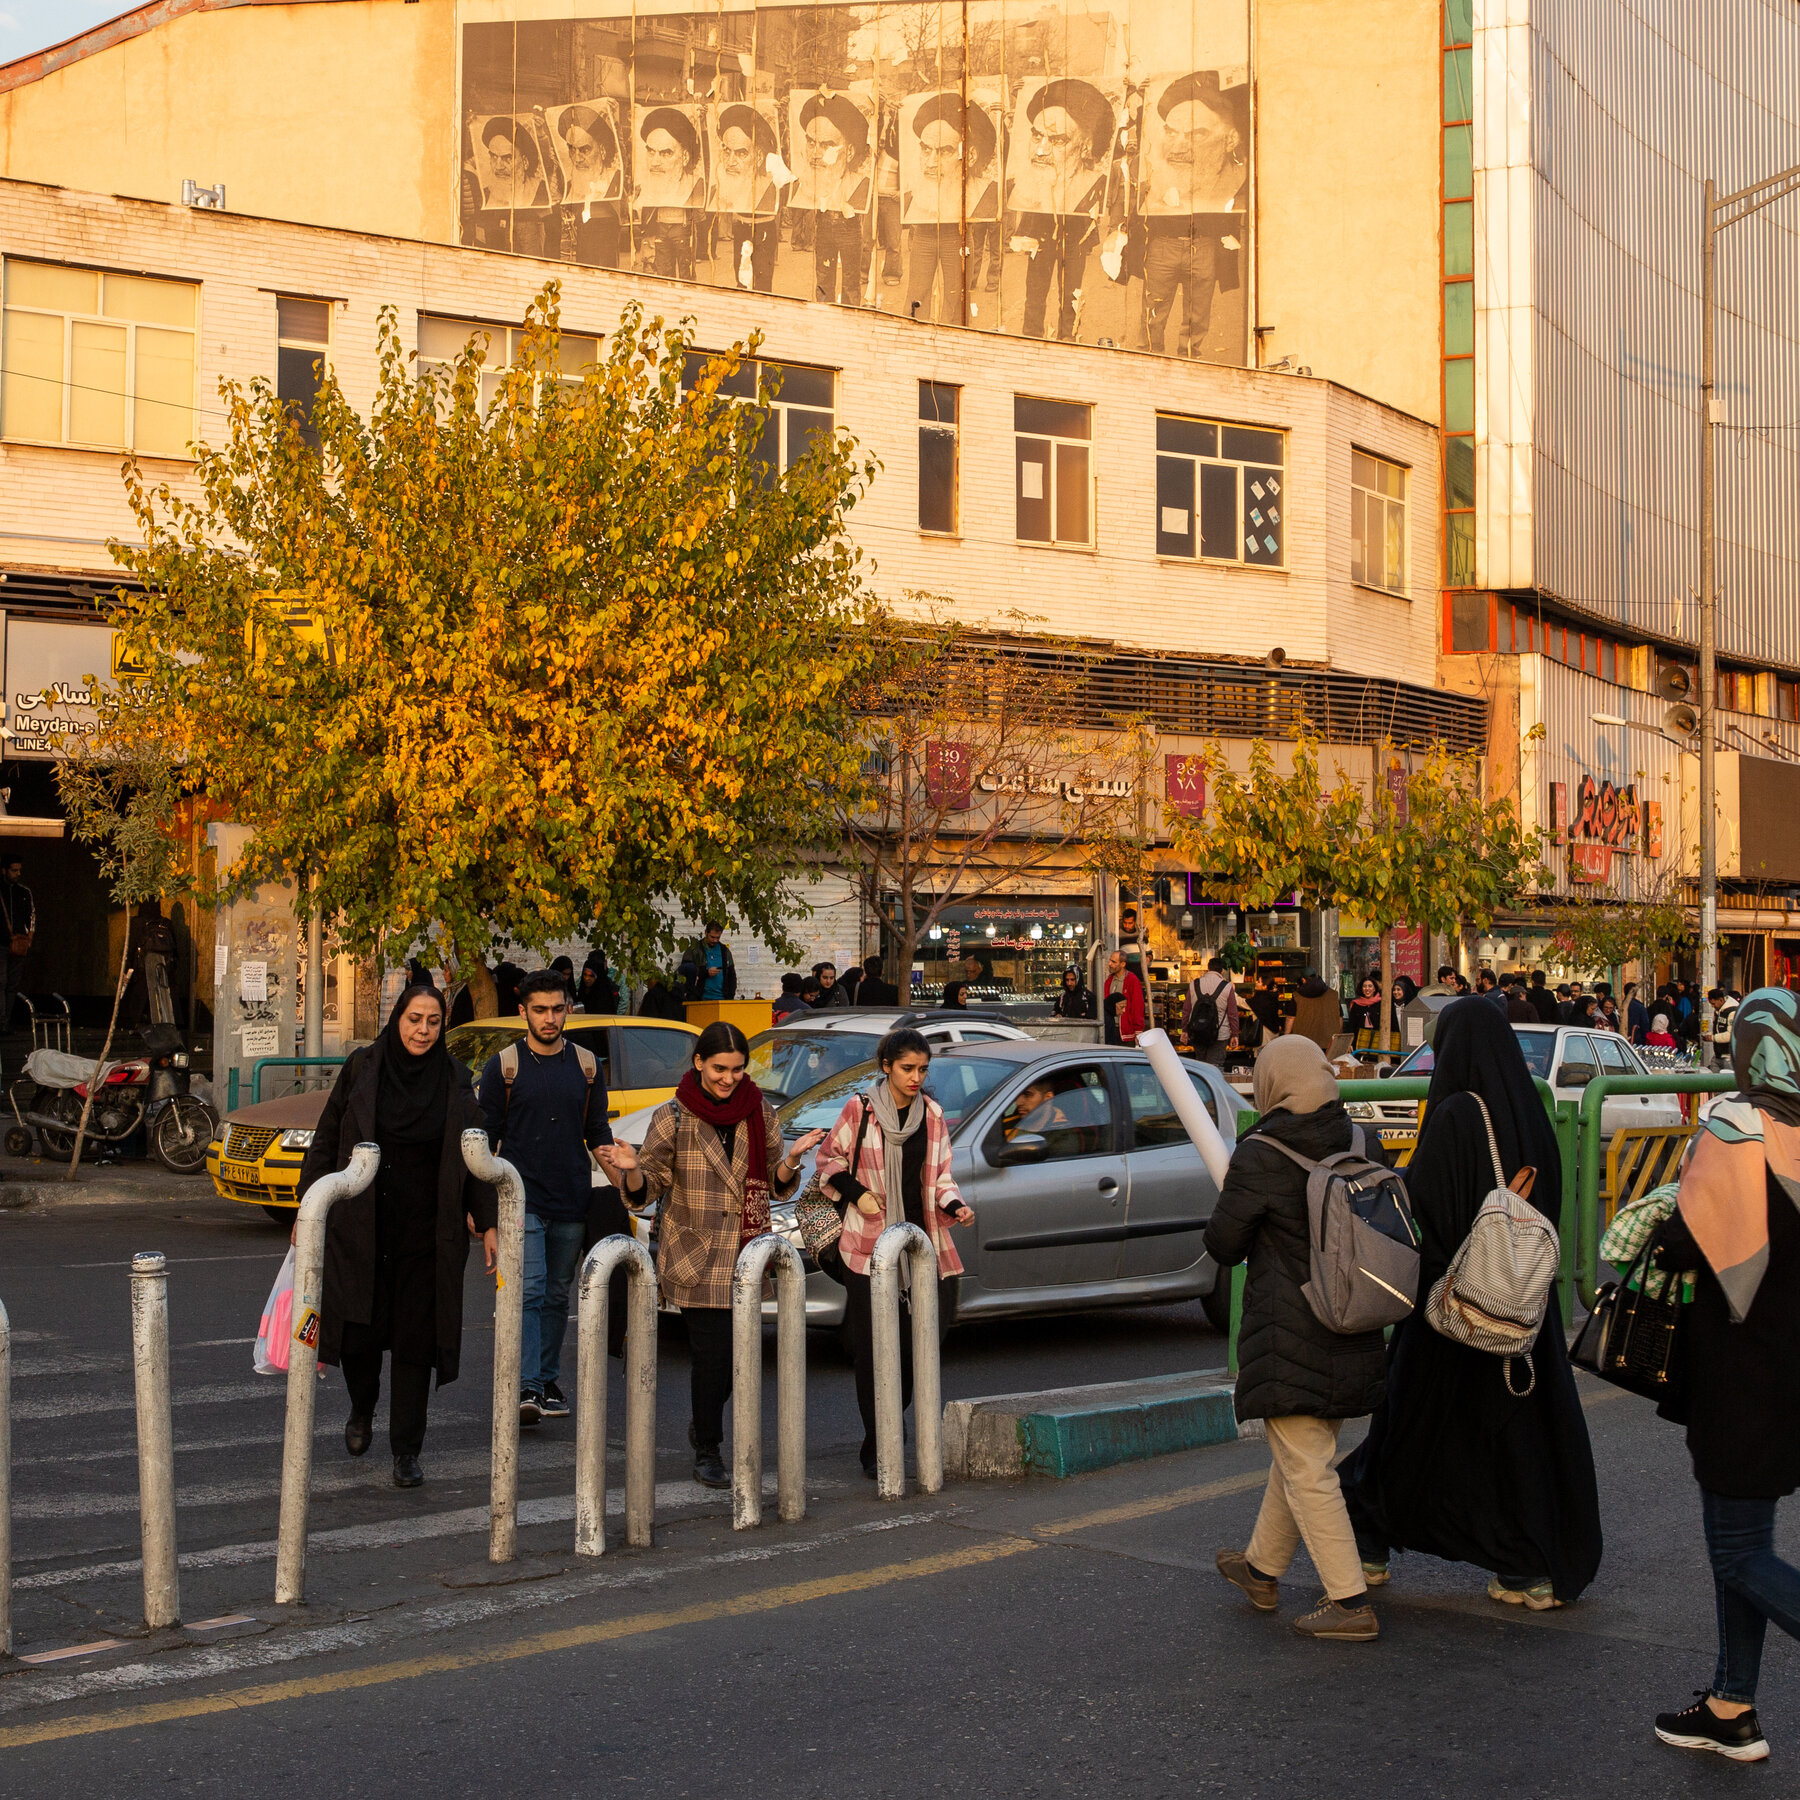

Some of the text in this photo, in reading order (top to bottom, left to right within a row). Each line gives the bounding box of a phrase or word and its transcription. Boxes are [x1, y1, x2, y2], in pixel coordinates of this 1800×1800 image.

[15, 714, 95, 735] Meydan-e
[15, 738, 53, 751] LINE4
[1383, 1131, 1394, 1139] ۵۷
